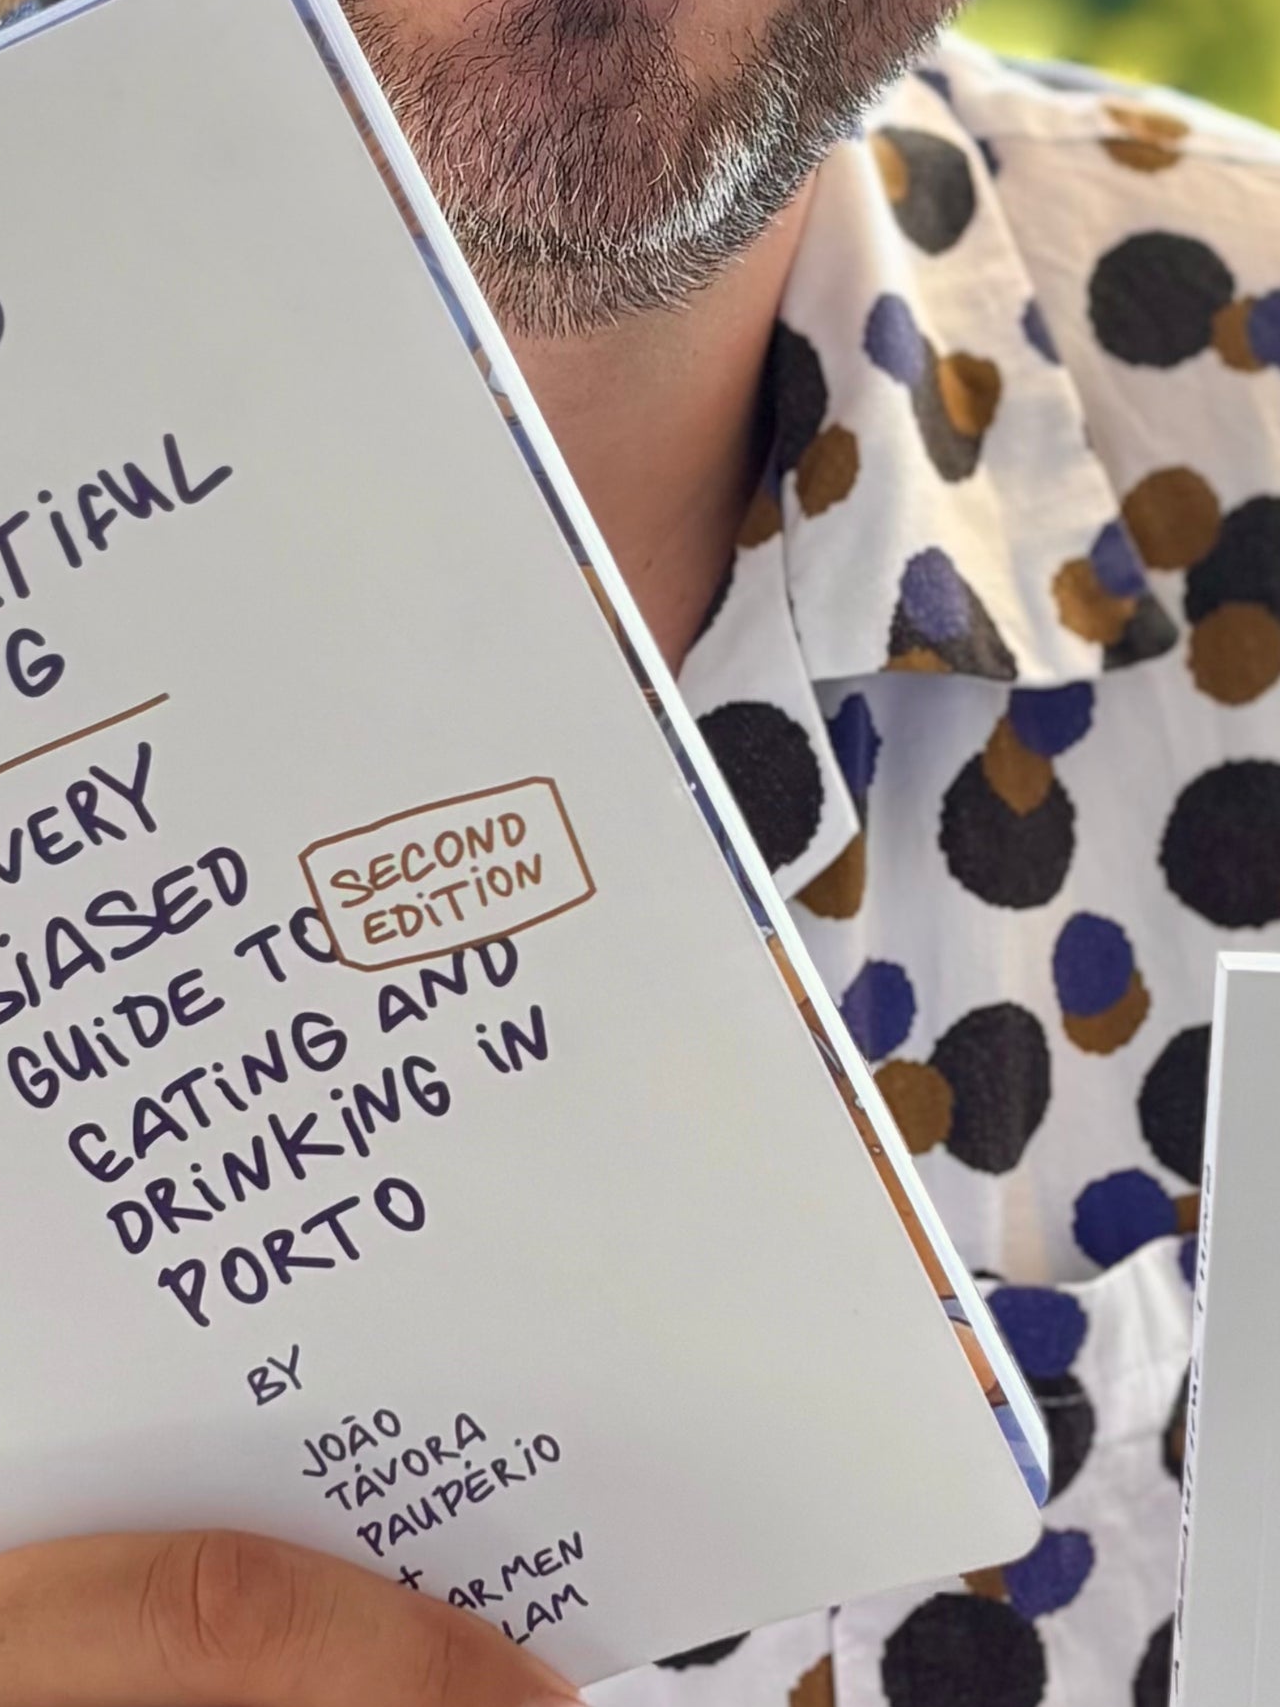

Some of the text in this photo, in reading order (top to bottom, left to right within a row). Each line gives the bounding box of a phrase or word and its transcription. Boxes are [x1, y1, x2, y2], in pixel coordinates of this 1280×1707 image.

[329, 812, 527, 909] SECOND
[234, 907, 336, 982] TO
[378, 939, 518, 1033] AND
[158, 1178, 425, 1327] PORTO
[247, 1344, 302, 1406] BY
[448, 1531, 583, 1609] ARMEN
[502, 1583, 588, 1644] LAM
